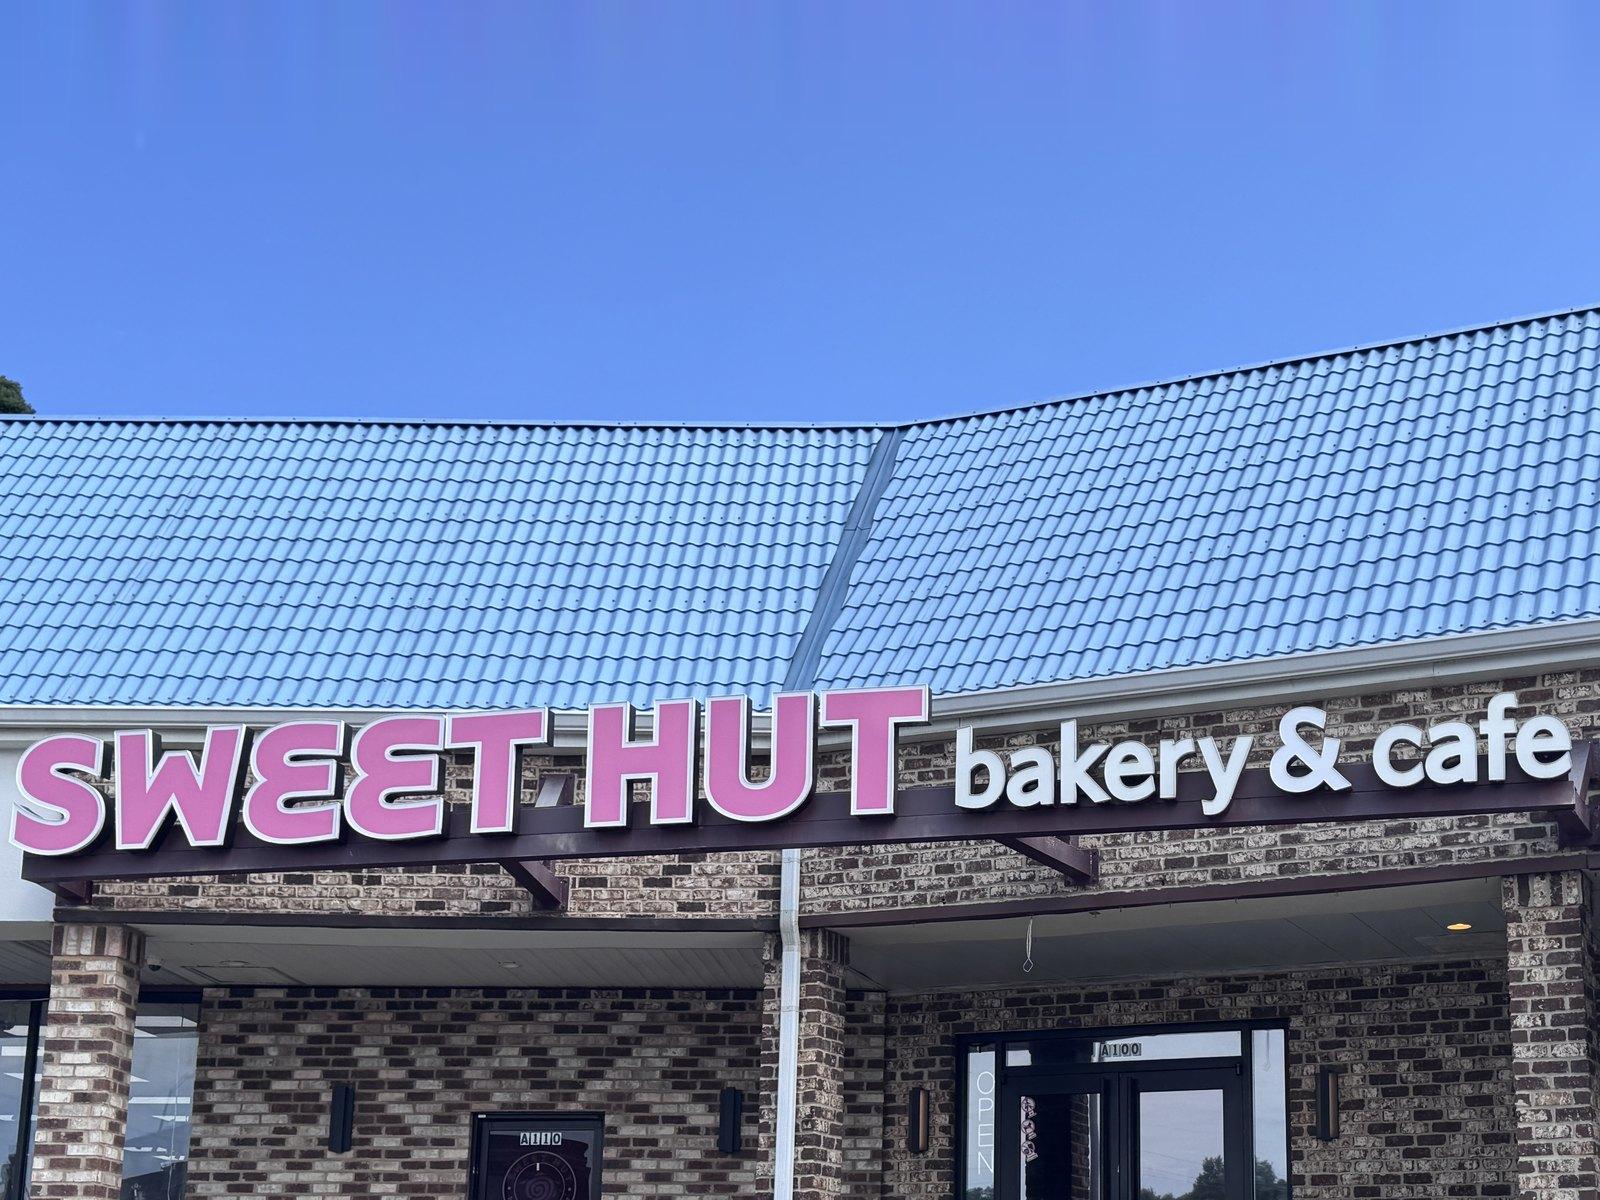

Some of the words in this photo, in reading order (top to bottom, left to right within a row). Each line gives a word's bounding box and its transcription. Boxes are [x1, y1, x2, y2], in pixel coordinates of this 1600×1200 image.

[9, 706, 552, 857] SWEET
[583, 684, 930, 828] HUT
[955, 718, 1253, 815] bakery
[1270, 706, 1352, 793] &
[1373, 692, 1572, 787] cafe
[1101, 1043, 1140, 1056] A100
[520, 1132, 561, 1145] A110
[976, 1070, 995, 1175] OPEN
